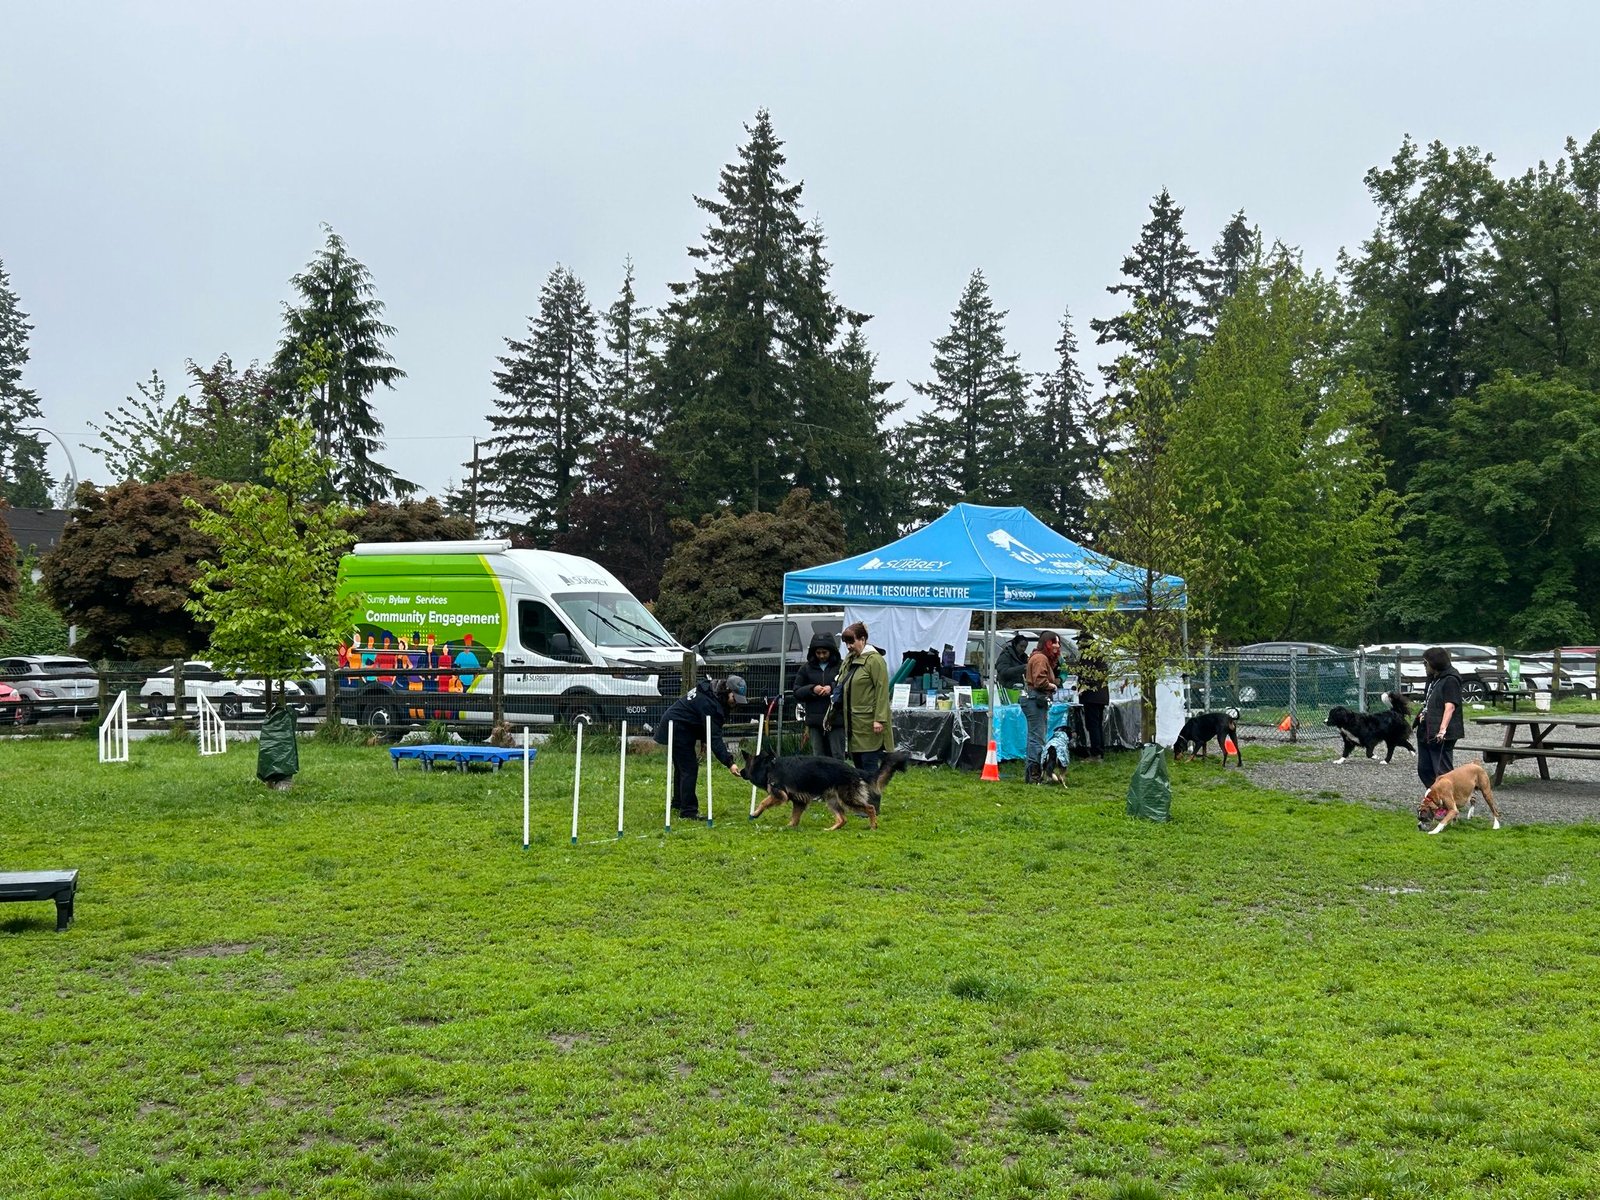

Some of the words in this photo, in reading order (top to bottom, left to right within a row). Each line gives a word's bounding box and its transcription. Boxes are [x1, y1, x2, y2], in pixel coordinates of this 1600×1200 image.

[880, 559, 952, 569] SURREY
[806, 583, 842, 596] SURREY
[843, 584, 880, 597] ANIMAL
[882, 585, 931, 598] RESOURCE
[932, 586, 970, 599] CENTRE
[367, 594, 387, 606] Surrey
[388, 594, 411, 606] Bylaw
[415, 594, 448, 605] Services
[365, 609, 426, 626] Community
[428, 610, 500, 627] Engagement
